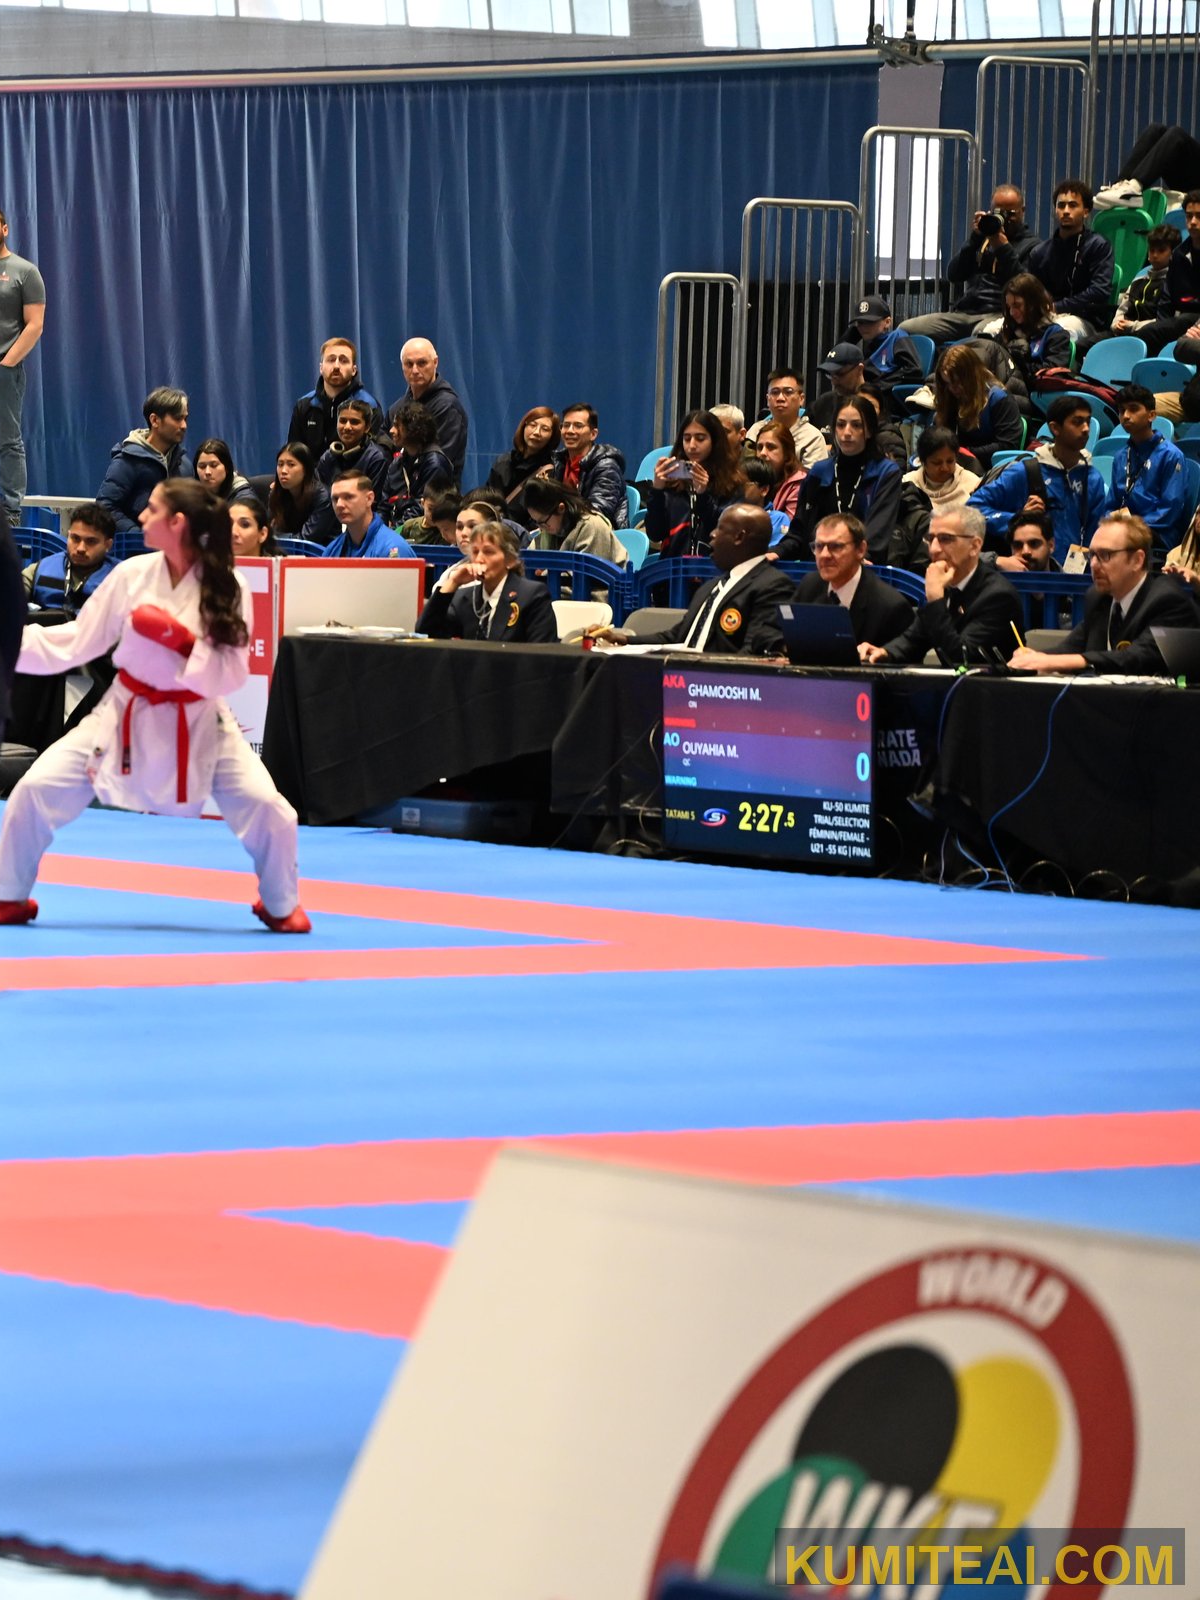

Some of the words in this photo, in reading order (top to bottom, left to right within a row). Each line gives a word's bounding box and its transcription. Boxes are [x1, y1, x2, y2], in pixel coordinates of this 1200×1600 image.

[663, 674, 686, 689] AKA
[688, 683, 748, 701] GHAMOOSHI
[749, 687, 762, 702] M.
[856, 692, 870, 721] 0
[663, 732, 680, 747] AO
[877, 729, 918, 748] RATE
[682, 741, 726, 758] OUYAHIA
[726, 744, 739, 759] M.
[877, 749, 921, 768] NADA
[856, 752, 870, 782] 0
[664, 774, 697, 787] WARNING
[665, 808, 690, 820] TATAMI
[813, 813, 870, 829] TRIAL/SELECTION
[838, 845, 848, 856] KG
[852, 846, 871, 858] FINAL
[916, 1252, 1070, 1332] WORLD
